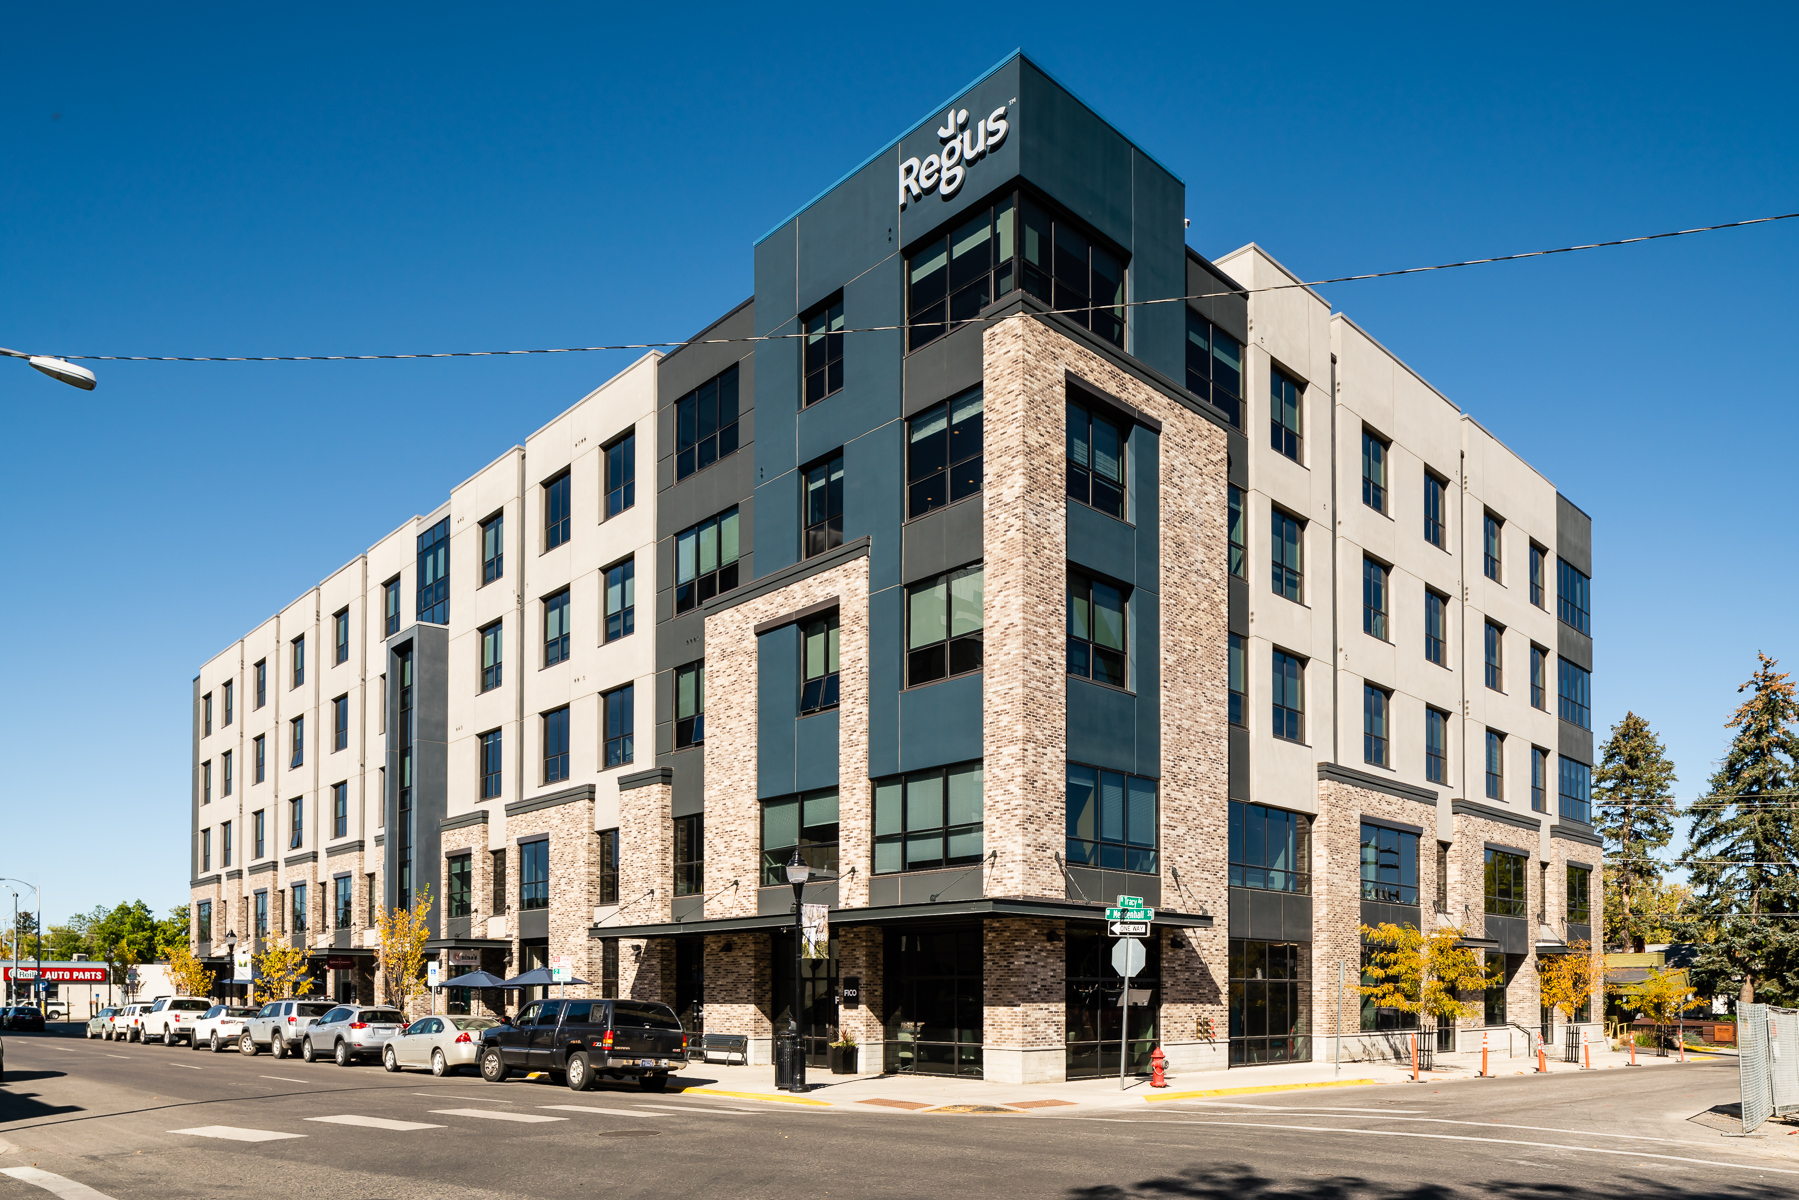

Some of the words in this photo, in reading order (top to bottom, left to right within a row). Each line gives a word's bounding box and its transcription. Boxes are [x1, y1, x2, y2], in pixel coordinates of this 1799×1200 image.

[899, 105, 1010, 206] Regus
[1124, 897, 1137, 908] Tracy
[45, 971, 71, 980] AUTO
[73, 971, 102, 980] PARTS
[844, 989, 857, 997] FICO
